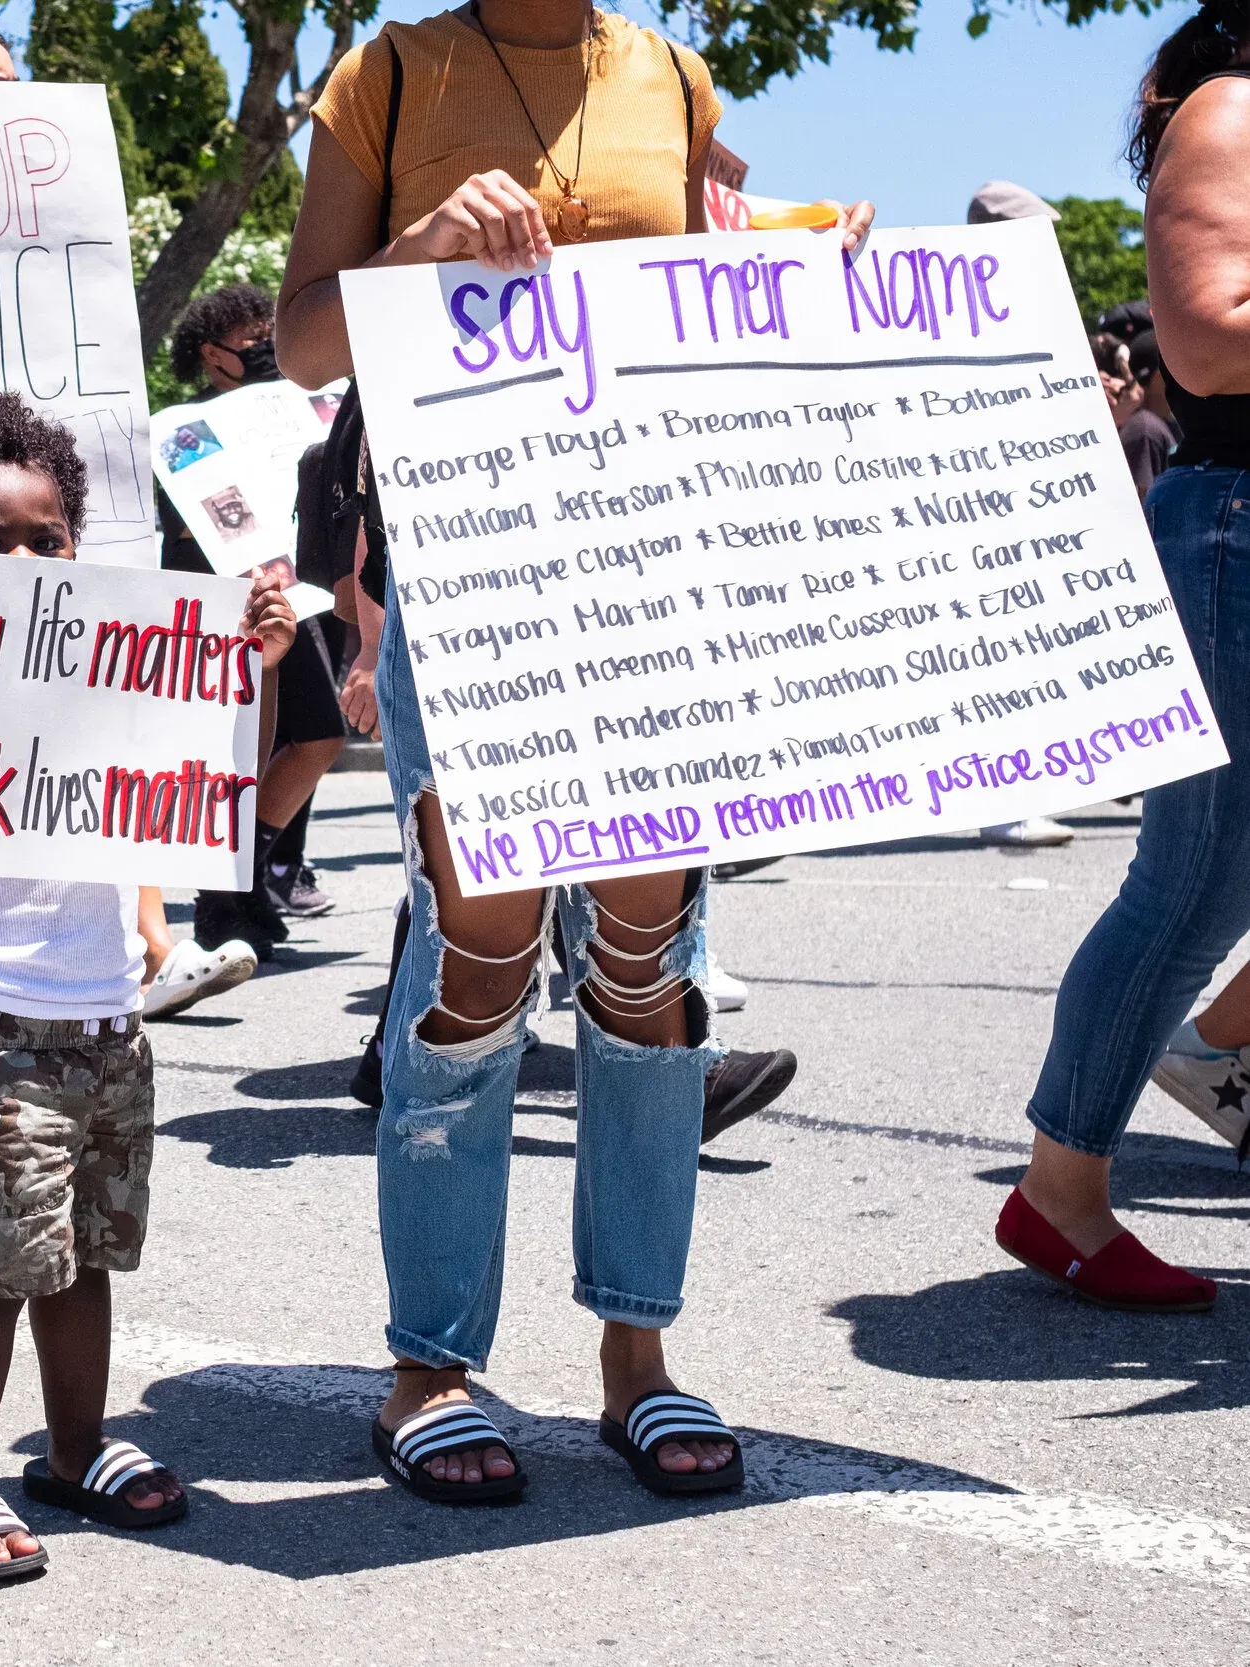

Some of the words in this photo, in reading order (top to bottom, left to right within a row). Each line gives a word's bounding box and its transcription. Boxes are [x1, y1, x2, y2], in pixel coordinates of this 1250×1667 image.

[639, 253, 804, 342] Their
[841, 248, 1009, 340] Name
[393, 447, 515, 489] George
[521, 420, 626, 470] Floyd
[658, 410, 791, 438] Breonna
[793, 403, 876, 442] Taylor
[920, 388, 1031, 417] Botham
[1039, 374, 1096, 398] Jean
[413, 503, 536, 548] Atatiana
[555, 484, 673, 521] Jefferson
[695, 458, 821, 496] Philando
[835, 455, 923, 484] Castile
[950, 447, 996, 472] Eric
[999, 430, 1100, 466] Reason
[417, 559, 569, 605] Dominique
[577, 536, 681, 576] Clayton
[717, 518, 806, 548] Bettie
[814, 515, 881, 541] Jones
[914, 490, 1018, 527] Walter
[1028, 472, 1096, 508] Scott
[429, 619, 558, 660] Trayvon
[574, 596, 676, 632] Martin
[714, 583, 787, 608] Tamir
[801, 571, 854, 598] Rice
[899, 553, 957, 581] Eric
[973, 529, 1092, 570] Garner
[21, 576, 86, 683] life
[87, 597, 263, 707] matters
[442, 669, 565, 716] Natasha
[726, 624, 827, 662] Michelle
[829, 604, 939, 640] Cusseaux
[453, 729, 577, 770] Tanisha
[595, 699, 733, 743] Anderson
[771, 665, 898, 707] Jonathan
[906, 636, 1007, 681] Salcido
[1025, 610, 1111, 654] Michael
[1115, 597, 1174, 628] Brown
[20, 736, 101, 837] lives
[102, 759, 257, 853] matter
[479, 779, 590, 822] Jessica
[605, 752, 765, 795] Hernandez
[784, 733, 864, 766] Pamela
[863, 716, 942, 748] Turner
[458, 828, 522, 883] We
[533, 806, 700, 868] DEMAND
[714, 789, 816, 840] reform
[819, 783, 854, 821] in
[851, 773, 912, 812] the
